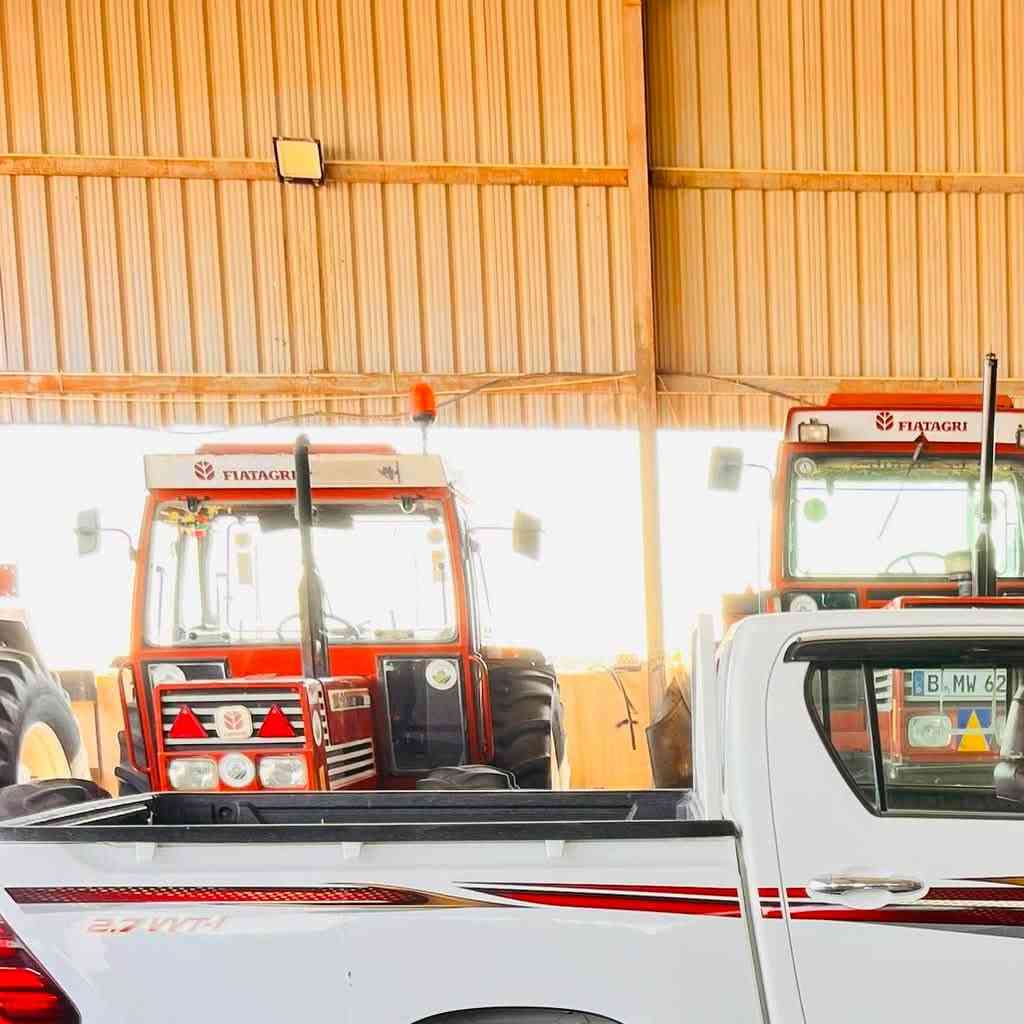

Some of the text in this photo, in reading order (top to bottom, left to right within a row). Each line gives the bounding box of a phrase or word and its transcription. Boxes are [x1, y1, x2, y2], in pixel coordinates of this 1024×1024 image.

[898, 421, 968, 432] FIATAGRI
[223, 470, 297, 481] FIATAGRI
[927, 674, 940, 692] B
[953, 674, 977, 692] MW
